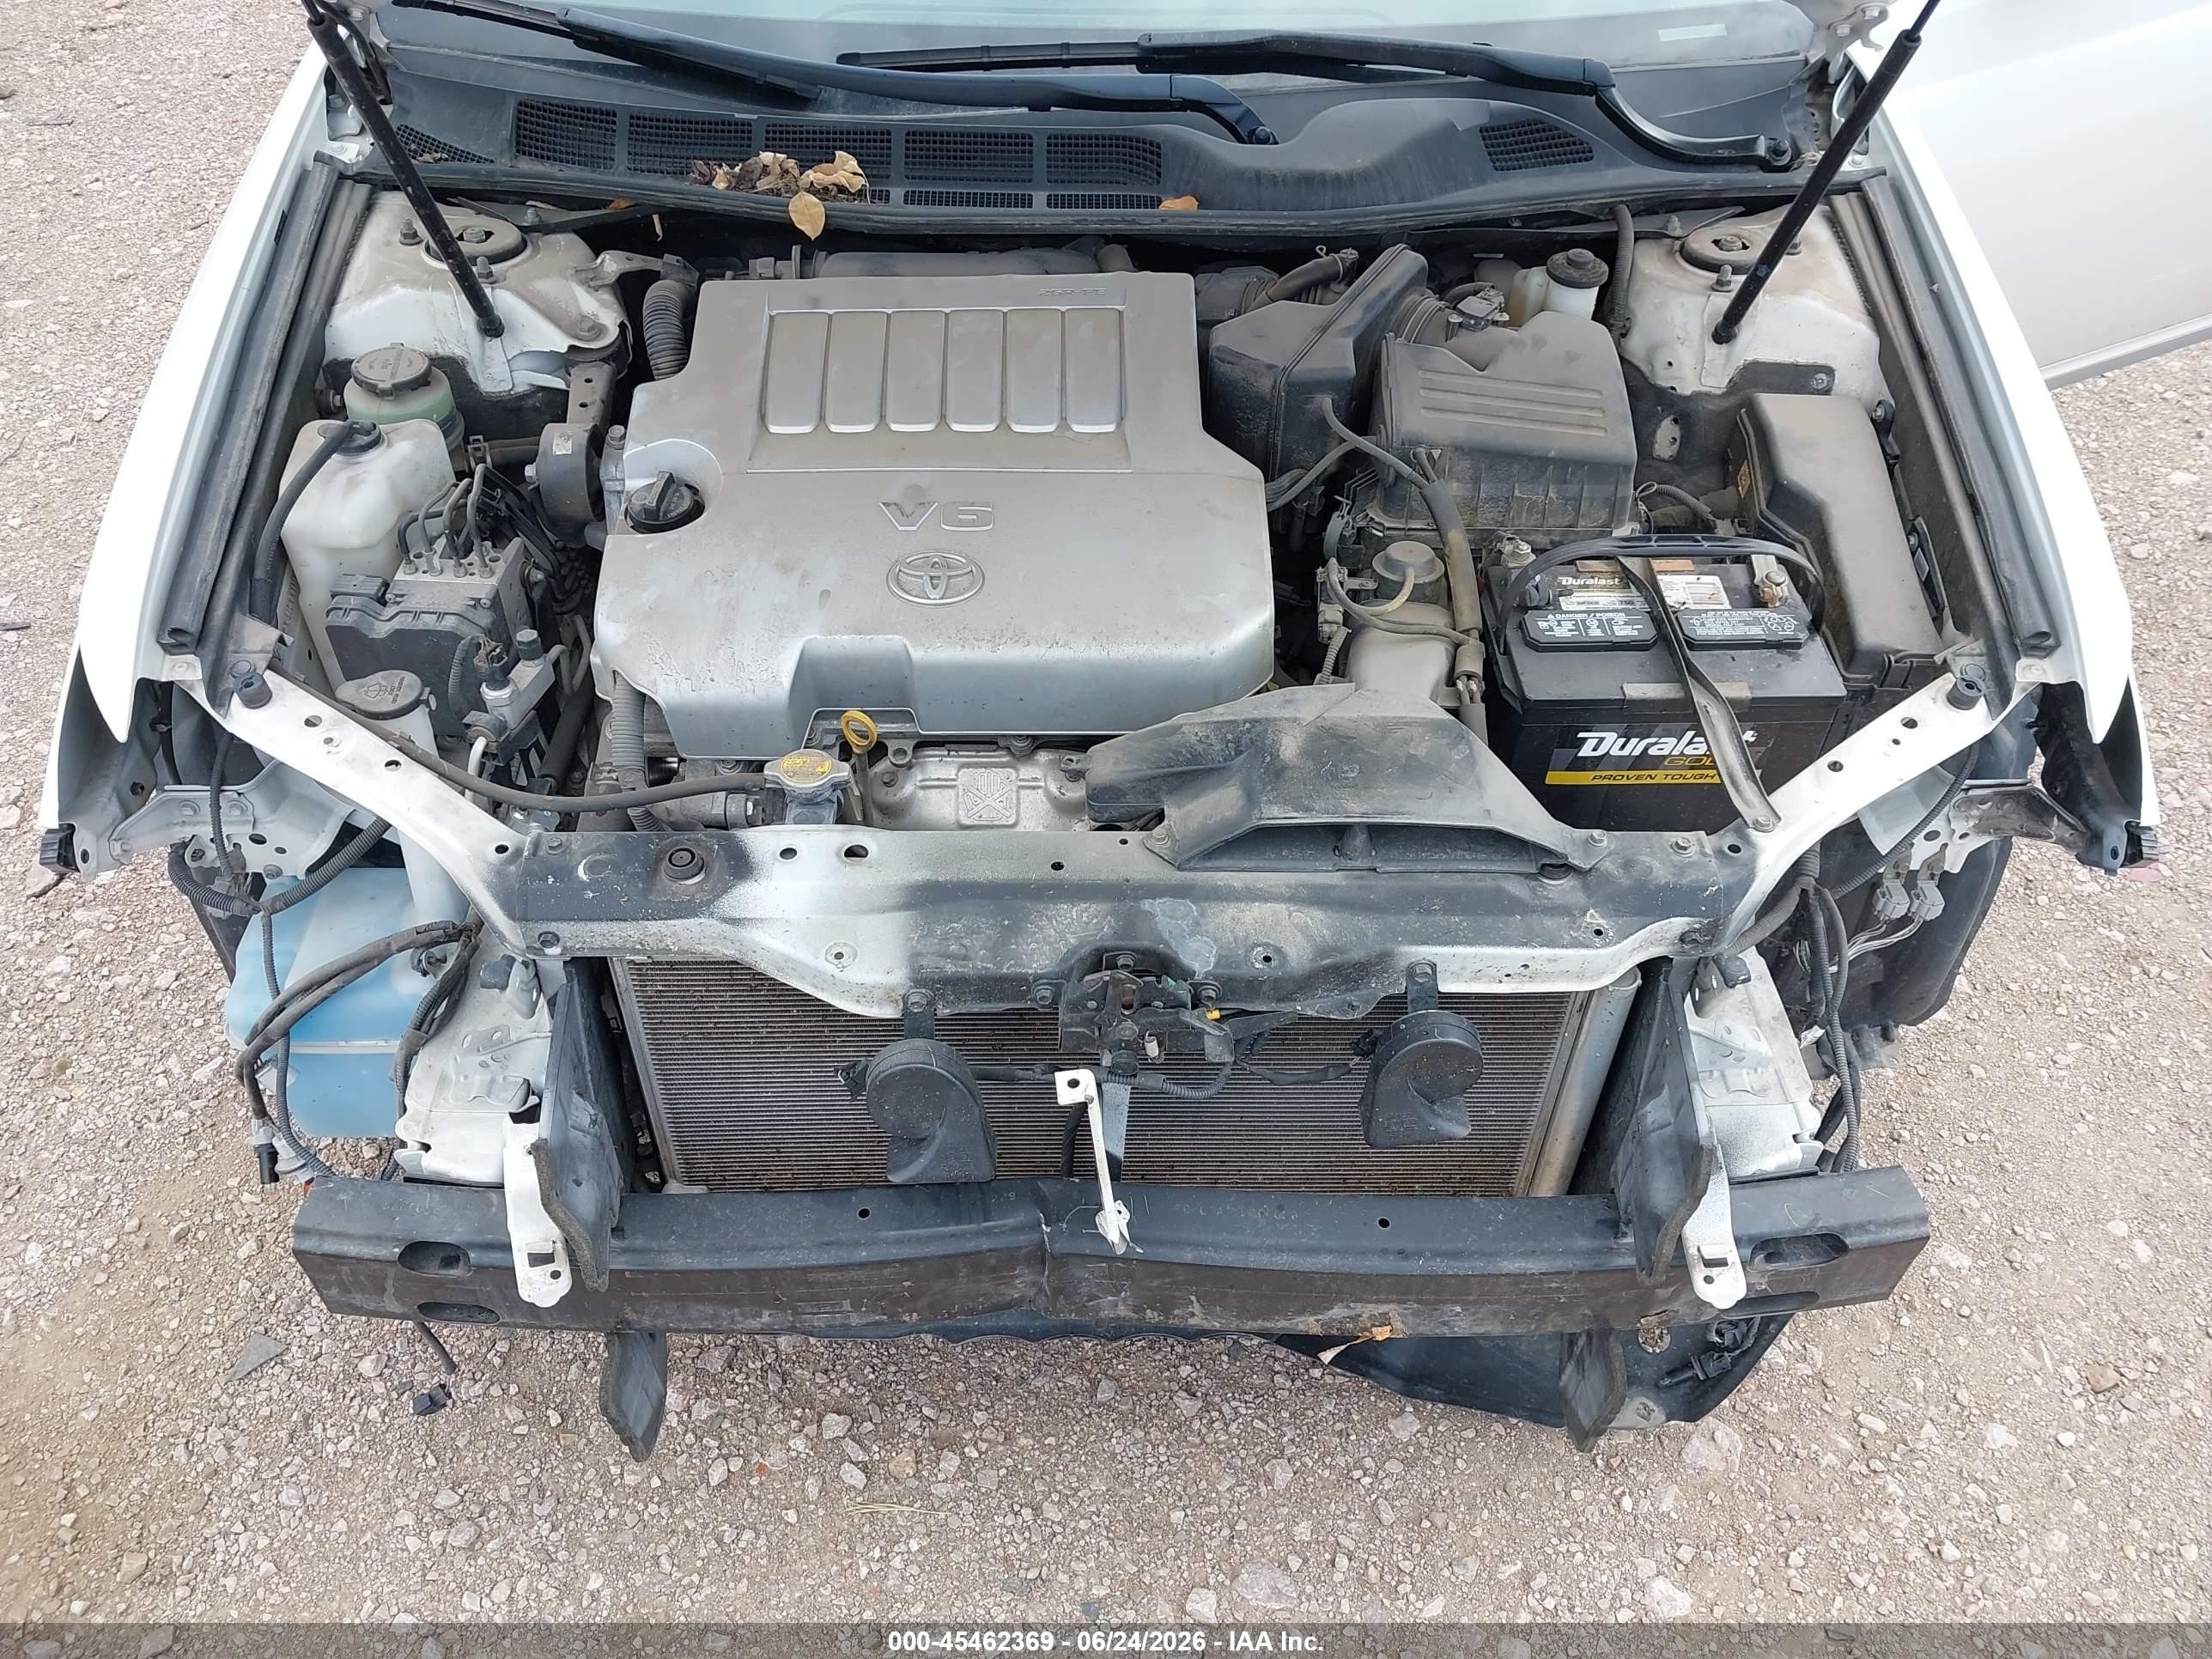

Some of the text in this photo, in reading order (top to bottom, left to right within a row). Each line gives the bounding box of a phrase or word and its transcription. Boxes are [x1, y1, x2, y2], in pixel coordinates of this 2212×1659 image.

[878, 501, 994, 532] V6
[1559, 576, 1620, 586] Duralast
[1663, 757, 1716, 766] GOL
